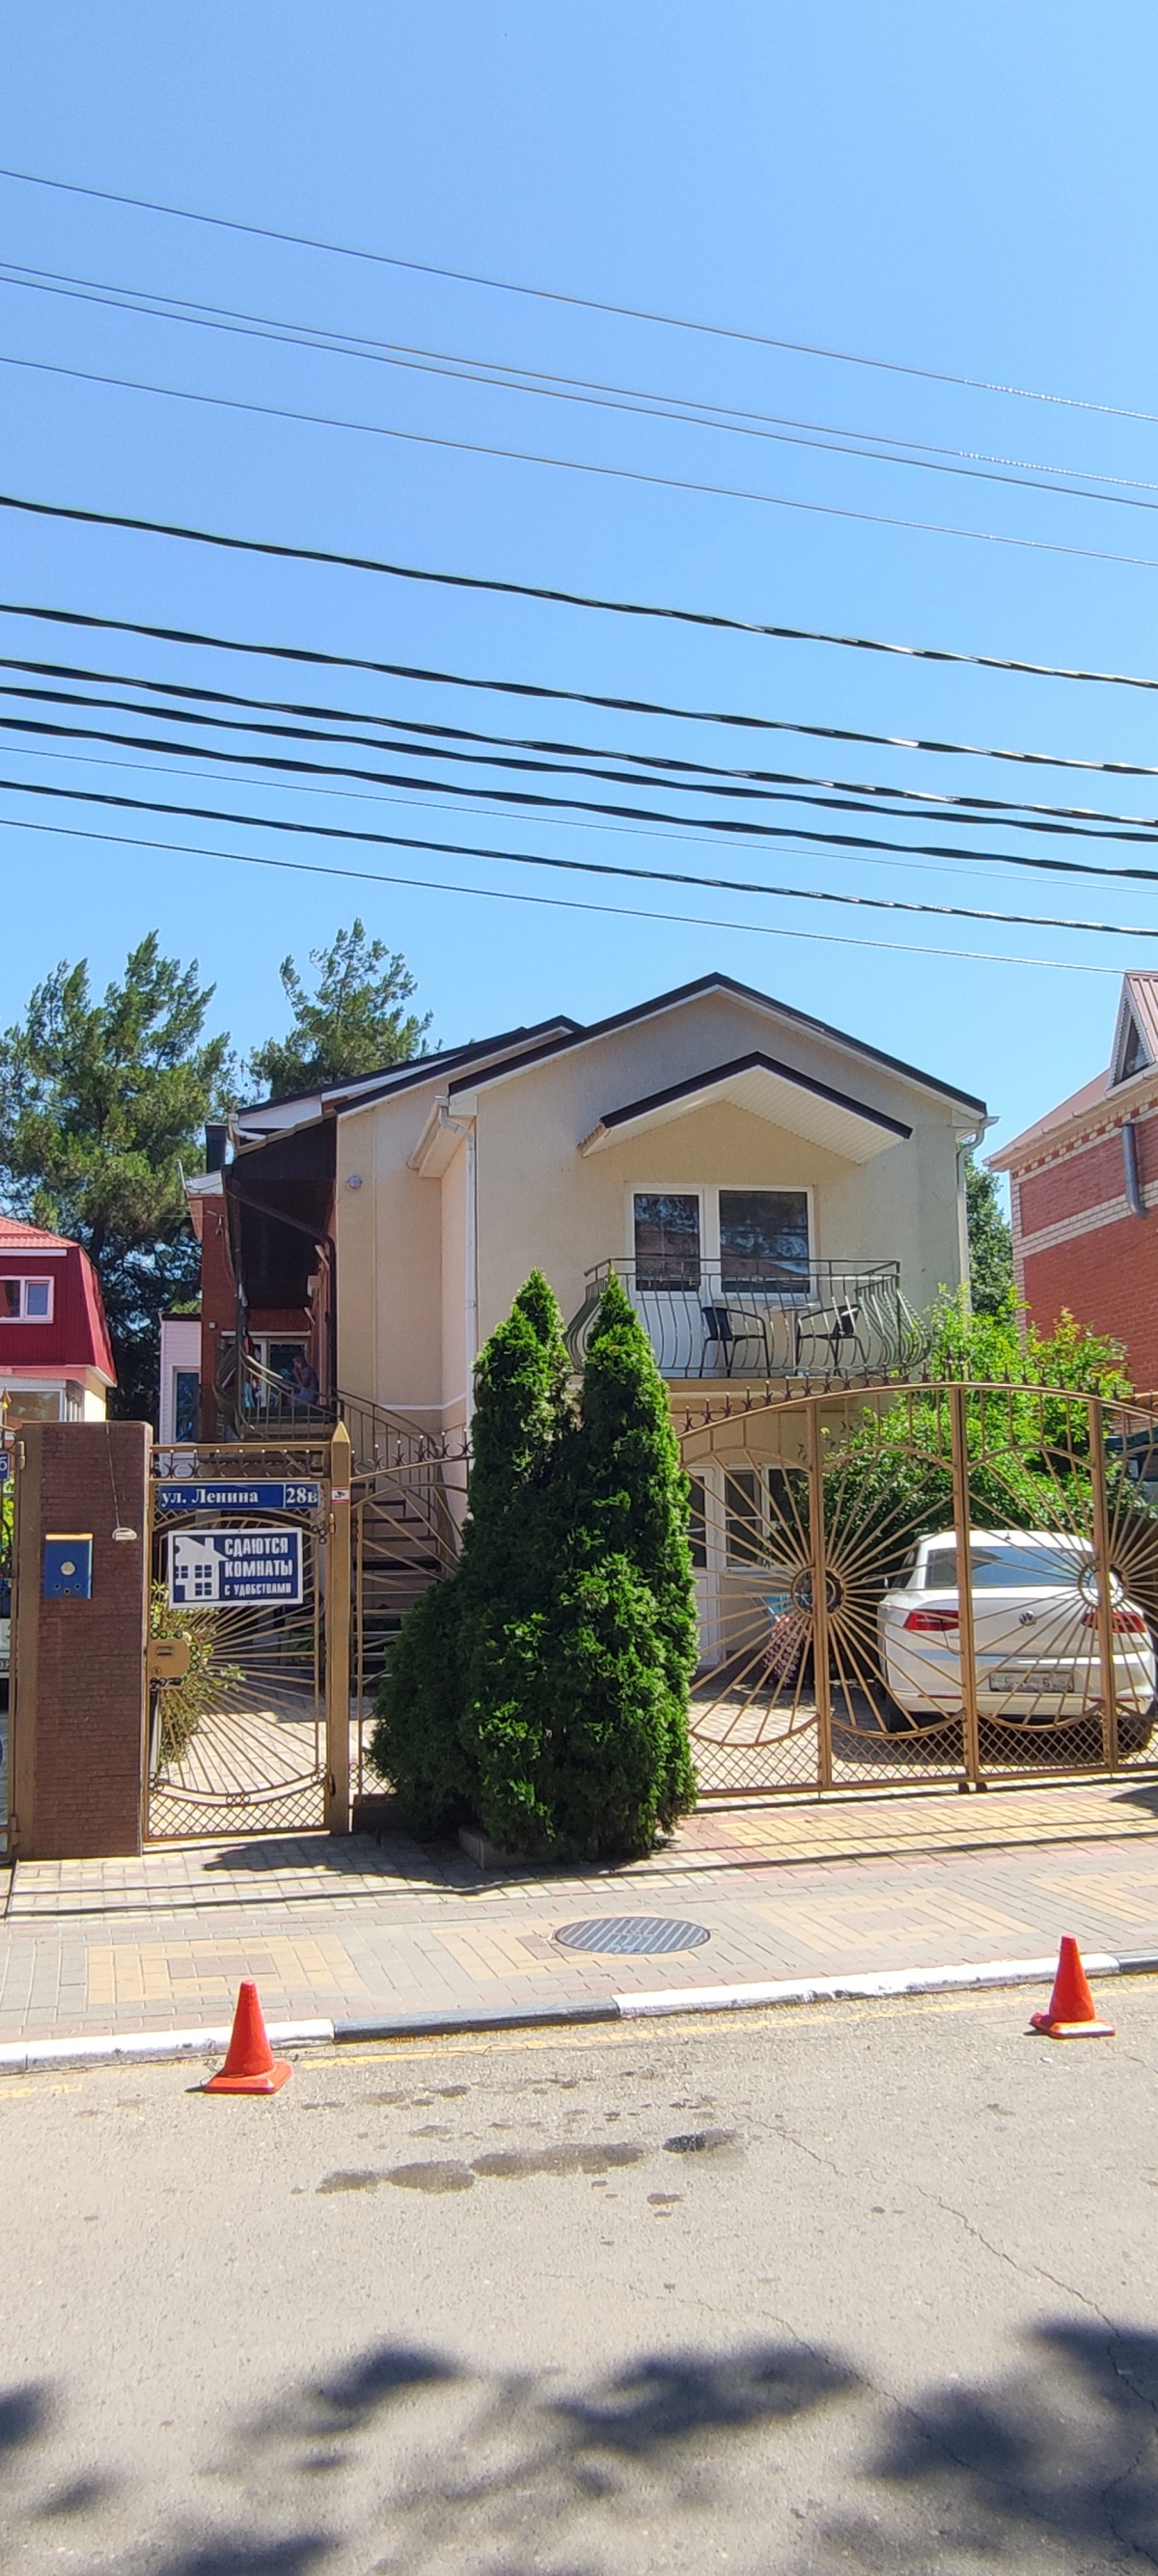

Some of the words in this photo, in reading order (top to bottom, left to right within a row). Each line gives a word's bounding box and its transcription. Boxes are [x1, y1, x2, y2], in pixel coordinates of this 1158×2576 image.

[161, 1492, 186, 1508] ул.
[192, 1488, 259, 1504] Ленина
[286, 1486, 318, 1504] 28в
[224, 1537, 289, 1557] СДАЮТСЯ
[224, 1560, 292, 1578] КОМНАТЫ
[234, 1583, 291, 1596] УДОБСТВАМИ
